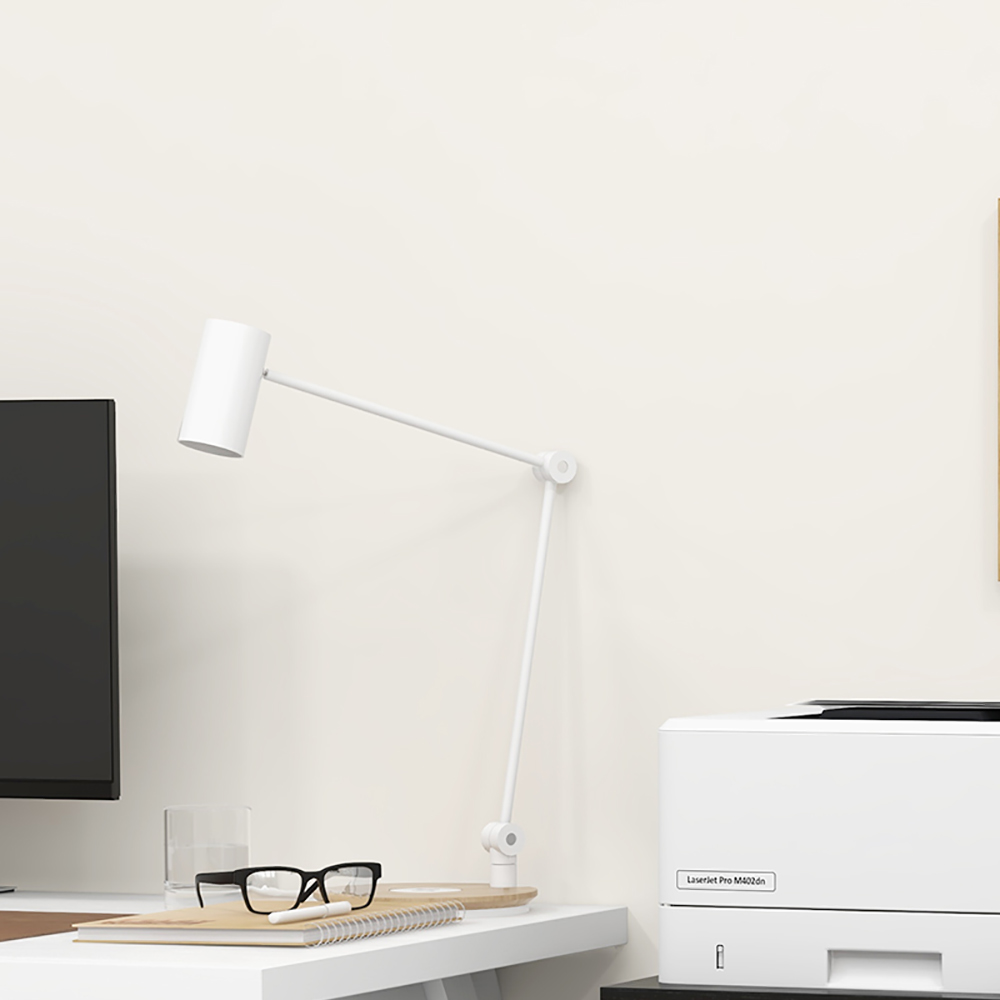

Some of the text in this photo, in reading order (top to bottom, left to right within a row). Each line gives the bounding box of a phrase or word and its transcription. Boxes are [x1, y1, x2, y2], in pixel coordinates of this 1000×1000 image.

[687, 875, 766, 886] LaserJet Pro M402dn
